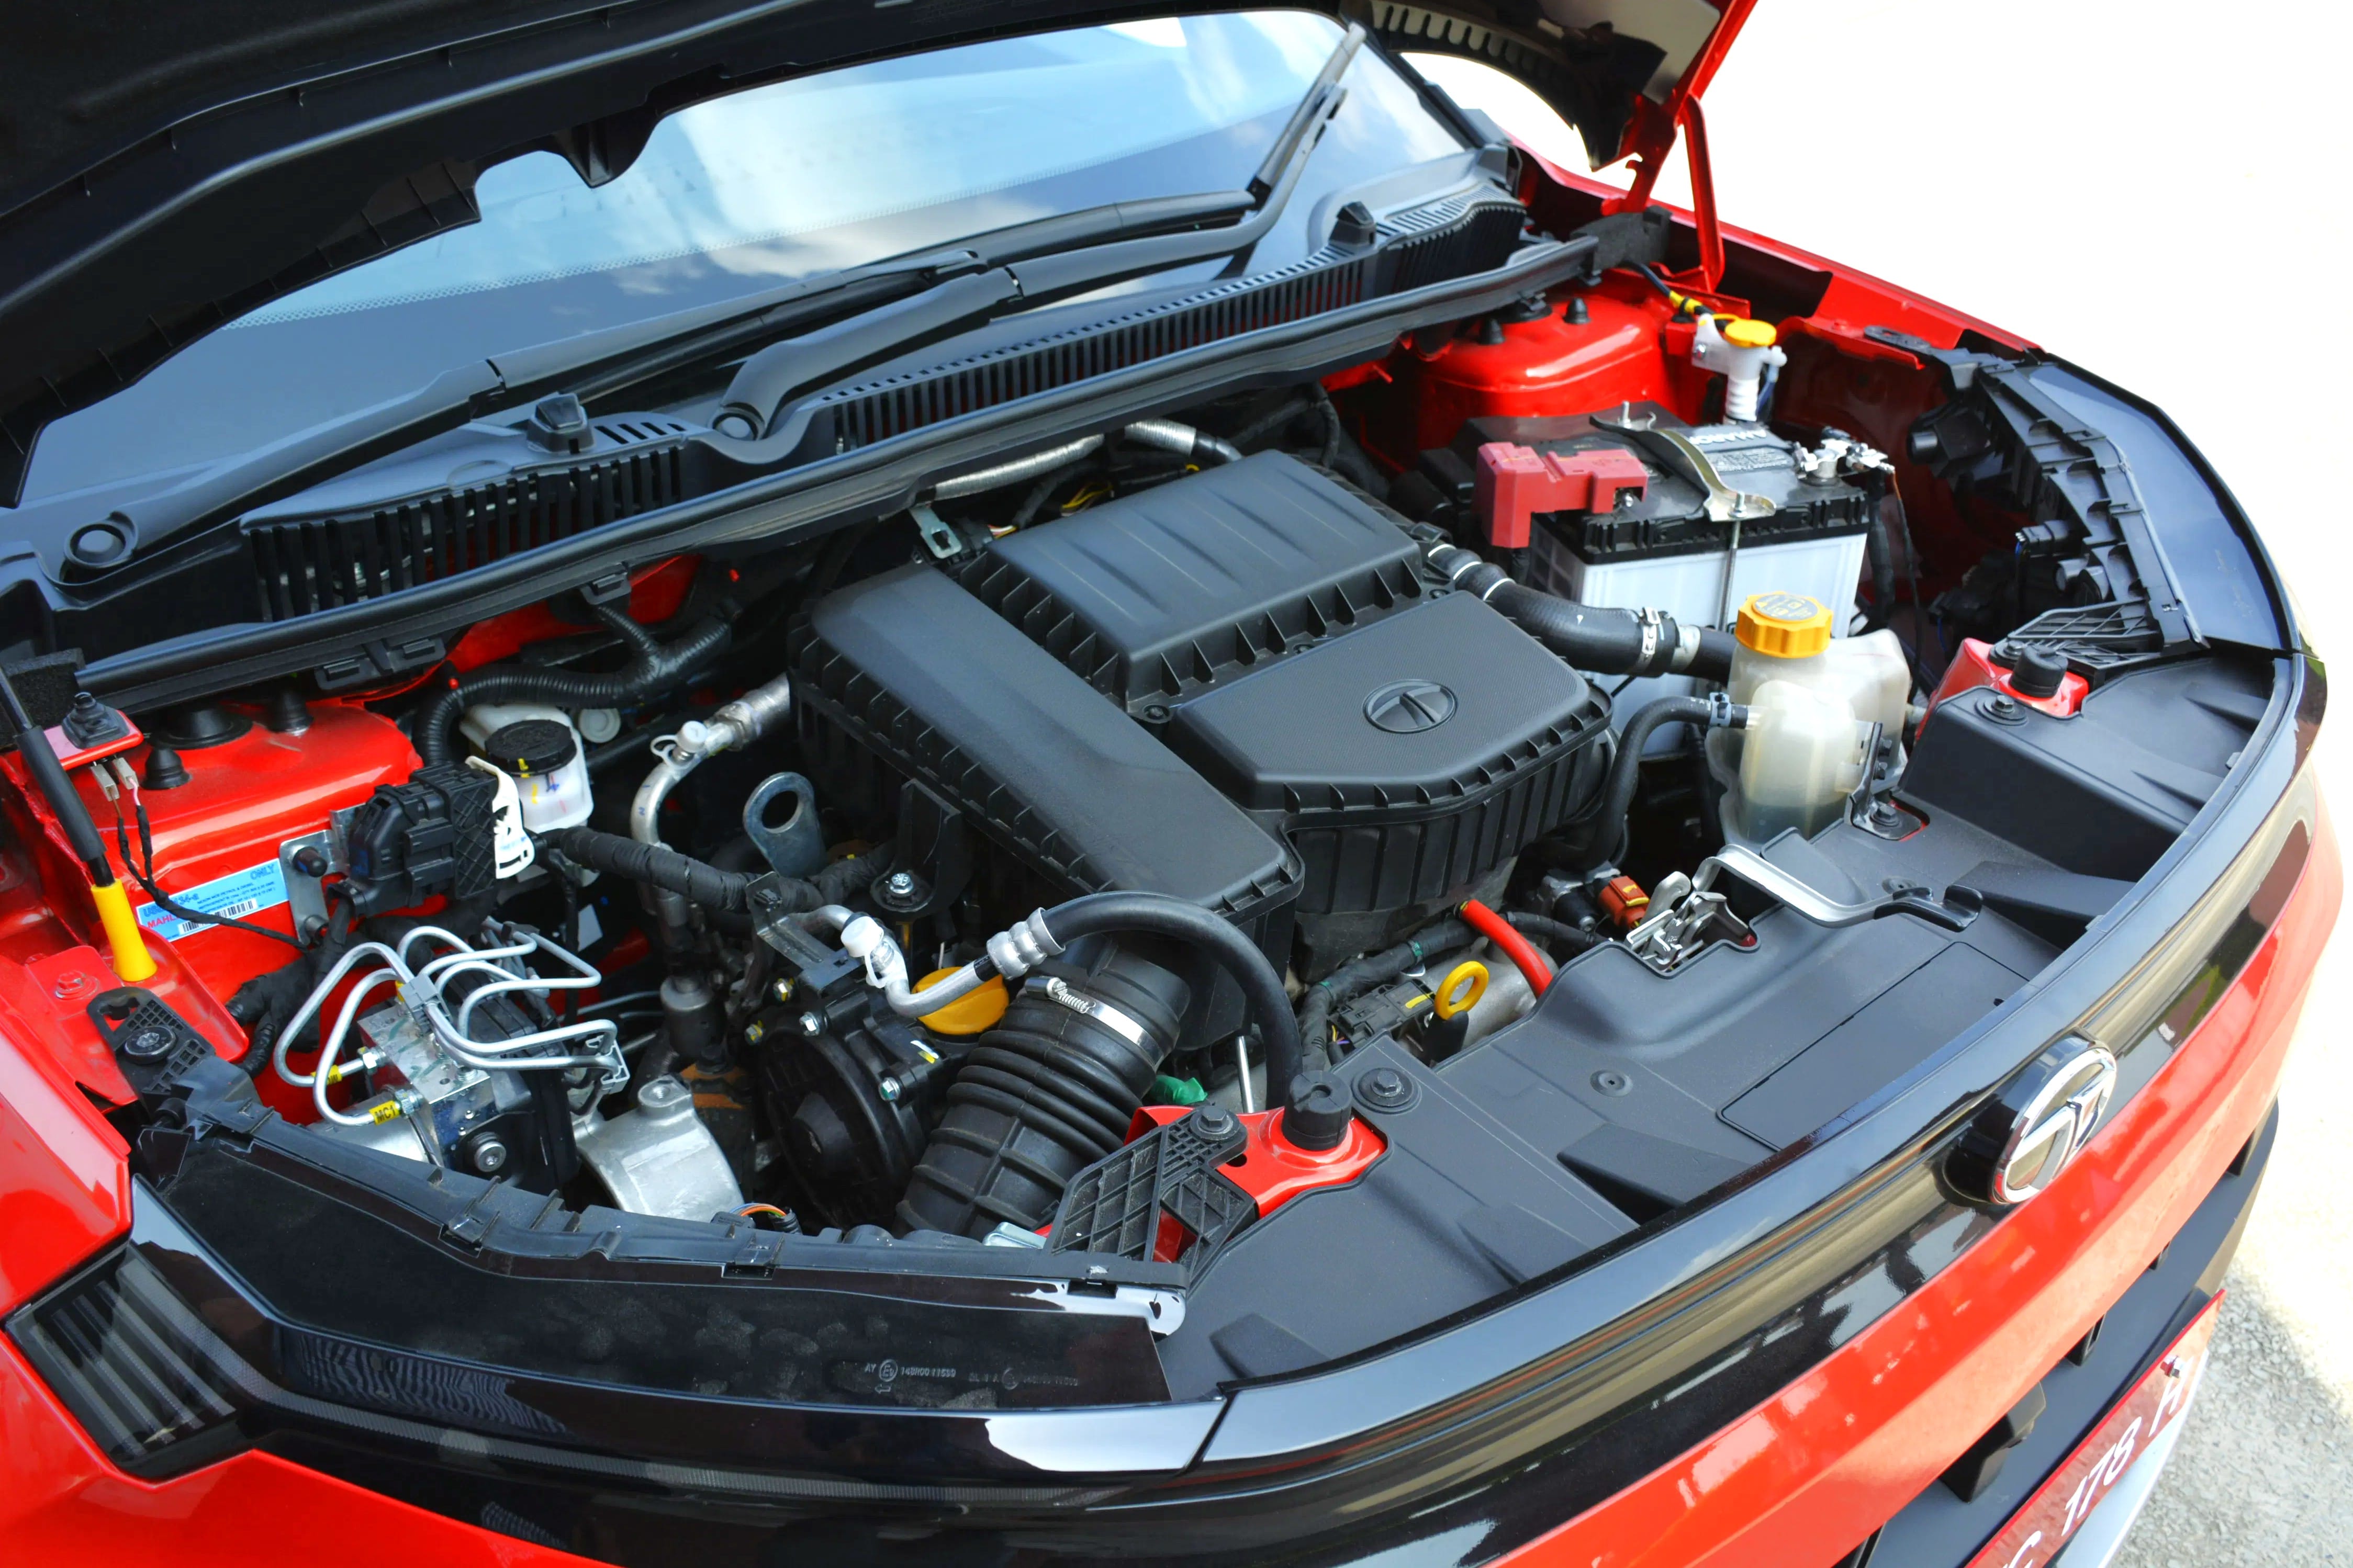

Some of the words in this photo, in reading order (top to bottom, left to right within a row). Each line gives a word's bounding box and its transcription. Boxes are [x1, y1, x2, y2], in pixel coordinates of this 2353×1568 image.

[250, 864, 275, 880] ONLY
[147, 913, 180, 928] MAHL
[375, 1105, 397, 1123] MC1
[2061, 1416, 2142, 1536] 178
